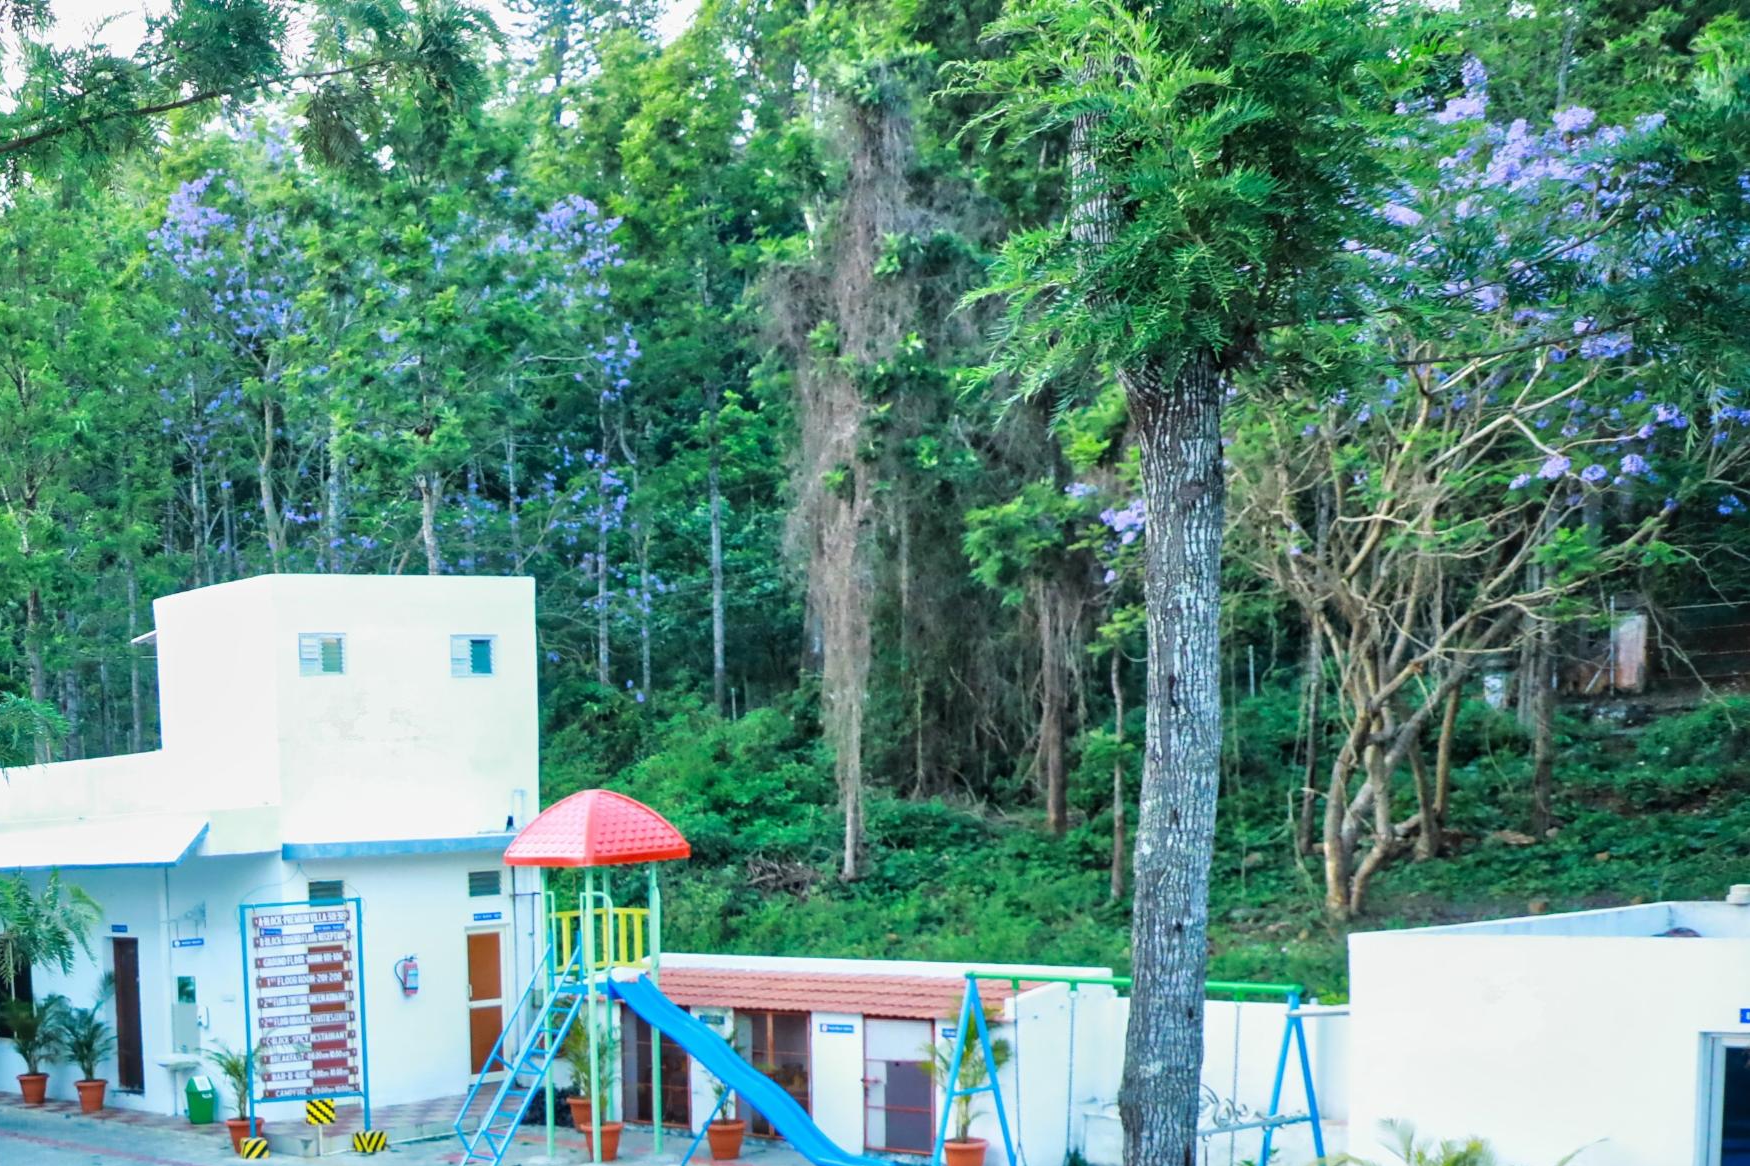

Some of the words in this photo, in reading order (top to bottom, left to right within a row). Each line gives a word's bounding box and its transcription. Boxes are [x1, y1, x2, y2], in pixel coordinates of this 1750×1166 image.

[276, 976, 298, 986] FLOOR
[310, 1032, 347, 1042] RESTAURANT
[270, 1053, 305, 1063] BREAKFAST
